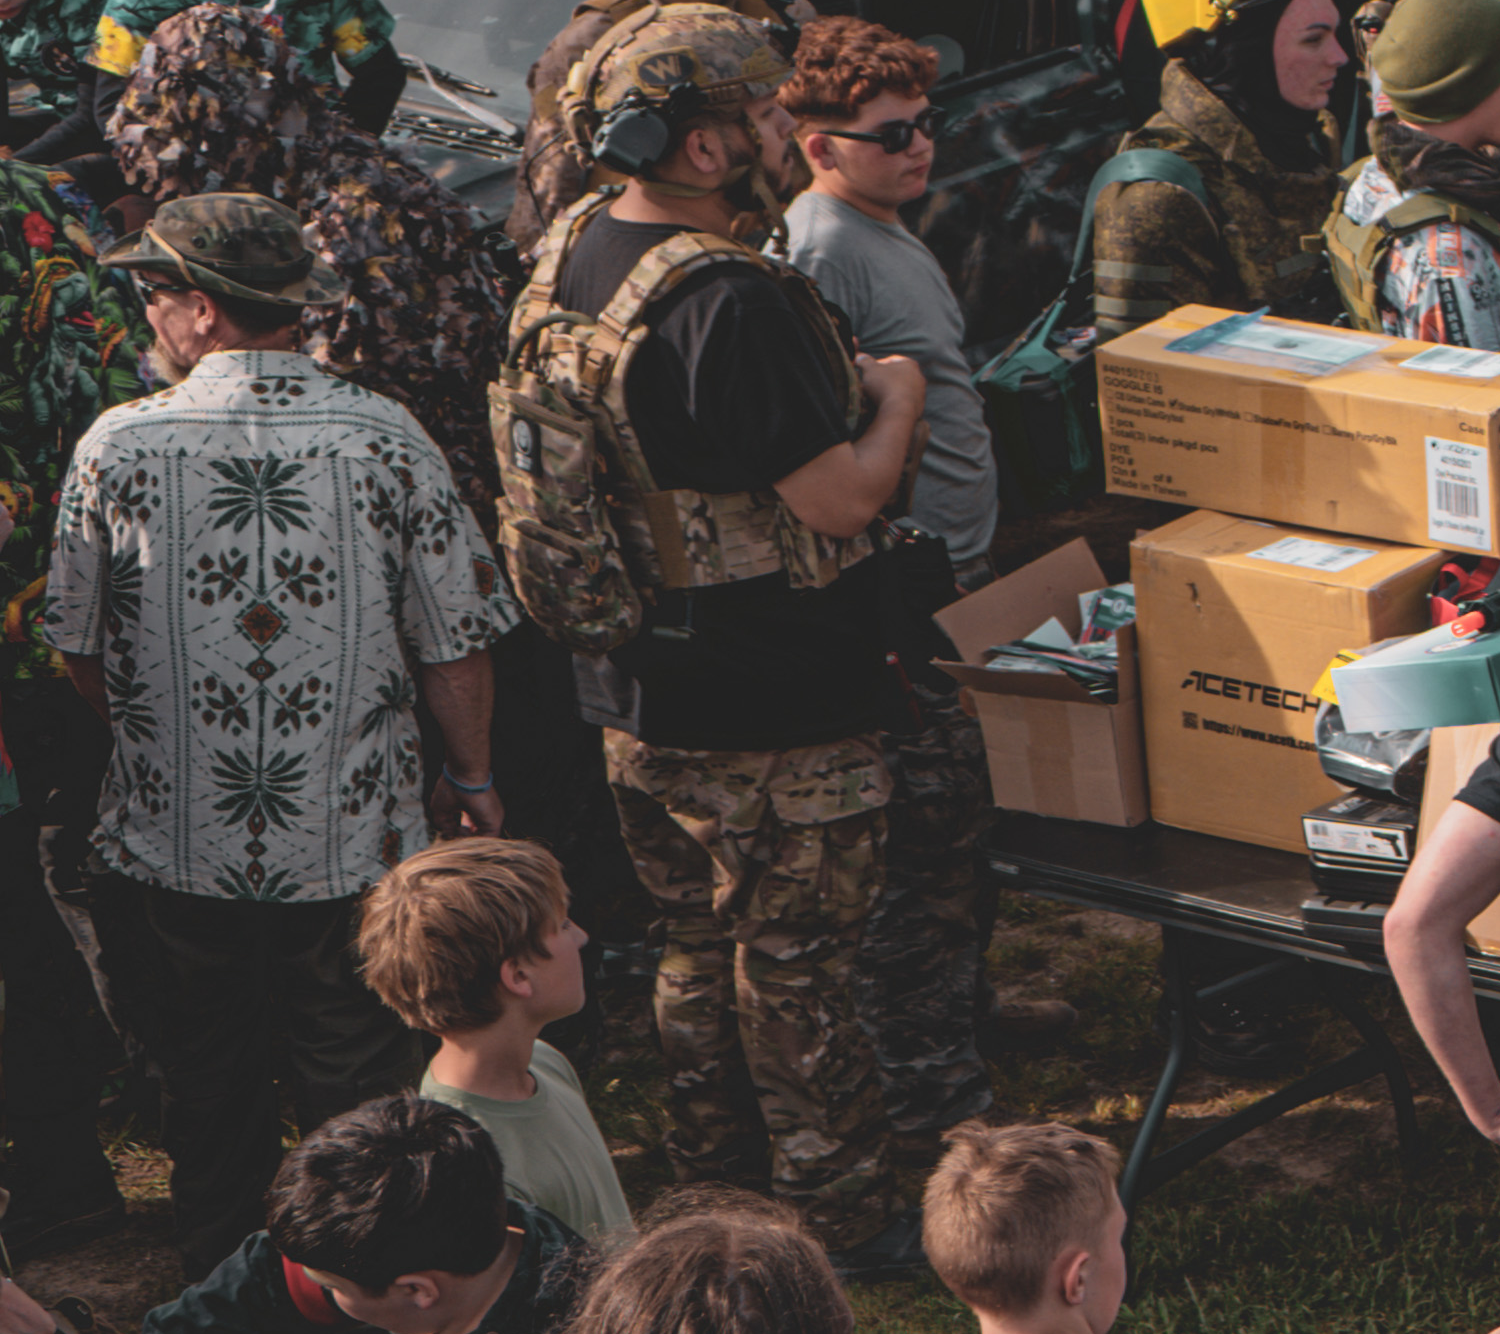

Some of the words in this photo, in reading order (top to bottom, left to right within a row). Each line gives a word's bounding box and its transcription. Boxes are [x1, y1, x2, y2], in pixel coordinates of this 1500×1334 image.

[1104, 376, 1151, 393] GOGGLE
[1459, 422, 1484, 435] Case
[1109, 443, 1131, 455] DYE
[1112, 477, 1139, 490] Made
[1152, 483, 1187, 498] Taiwan
[1181, 670, 1321, 713] ACETECH
